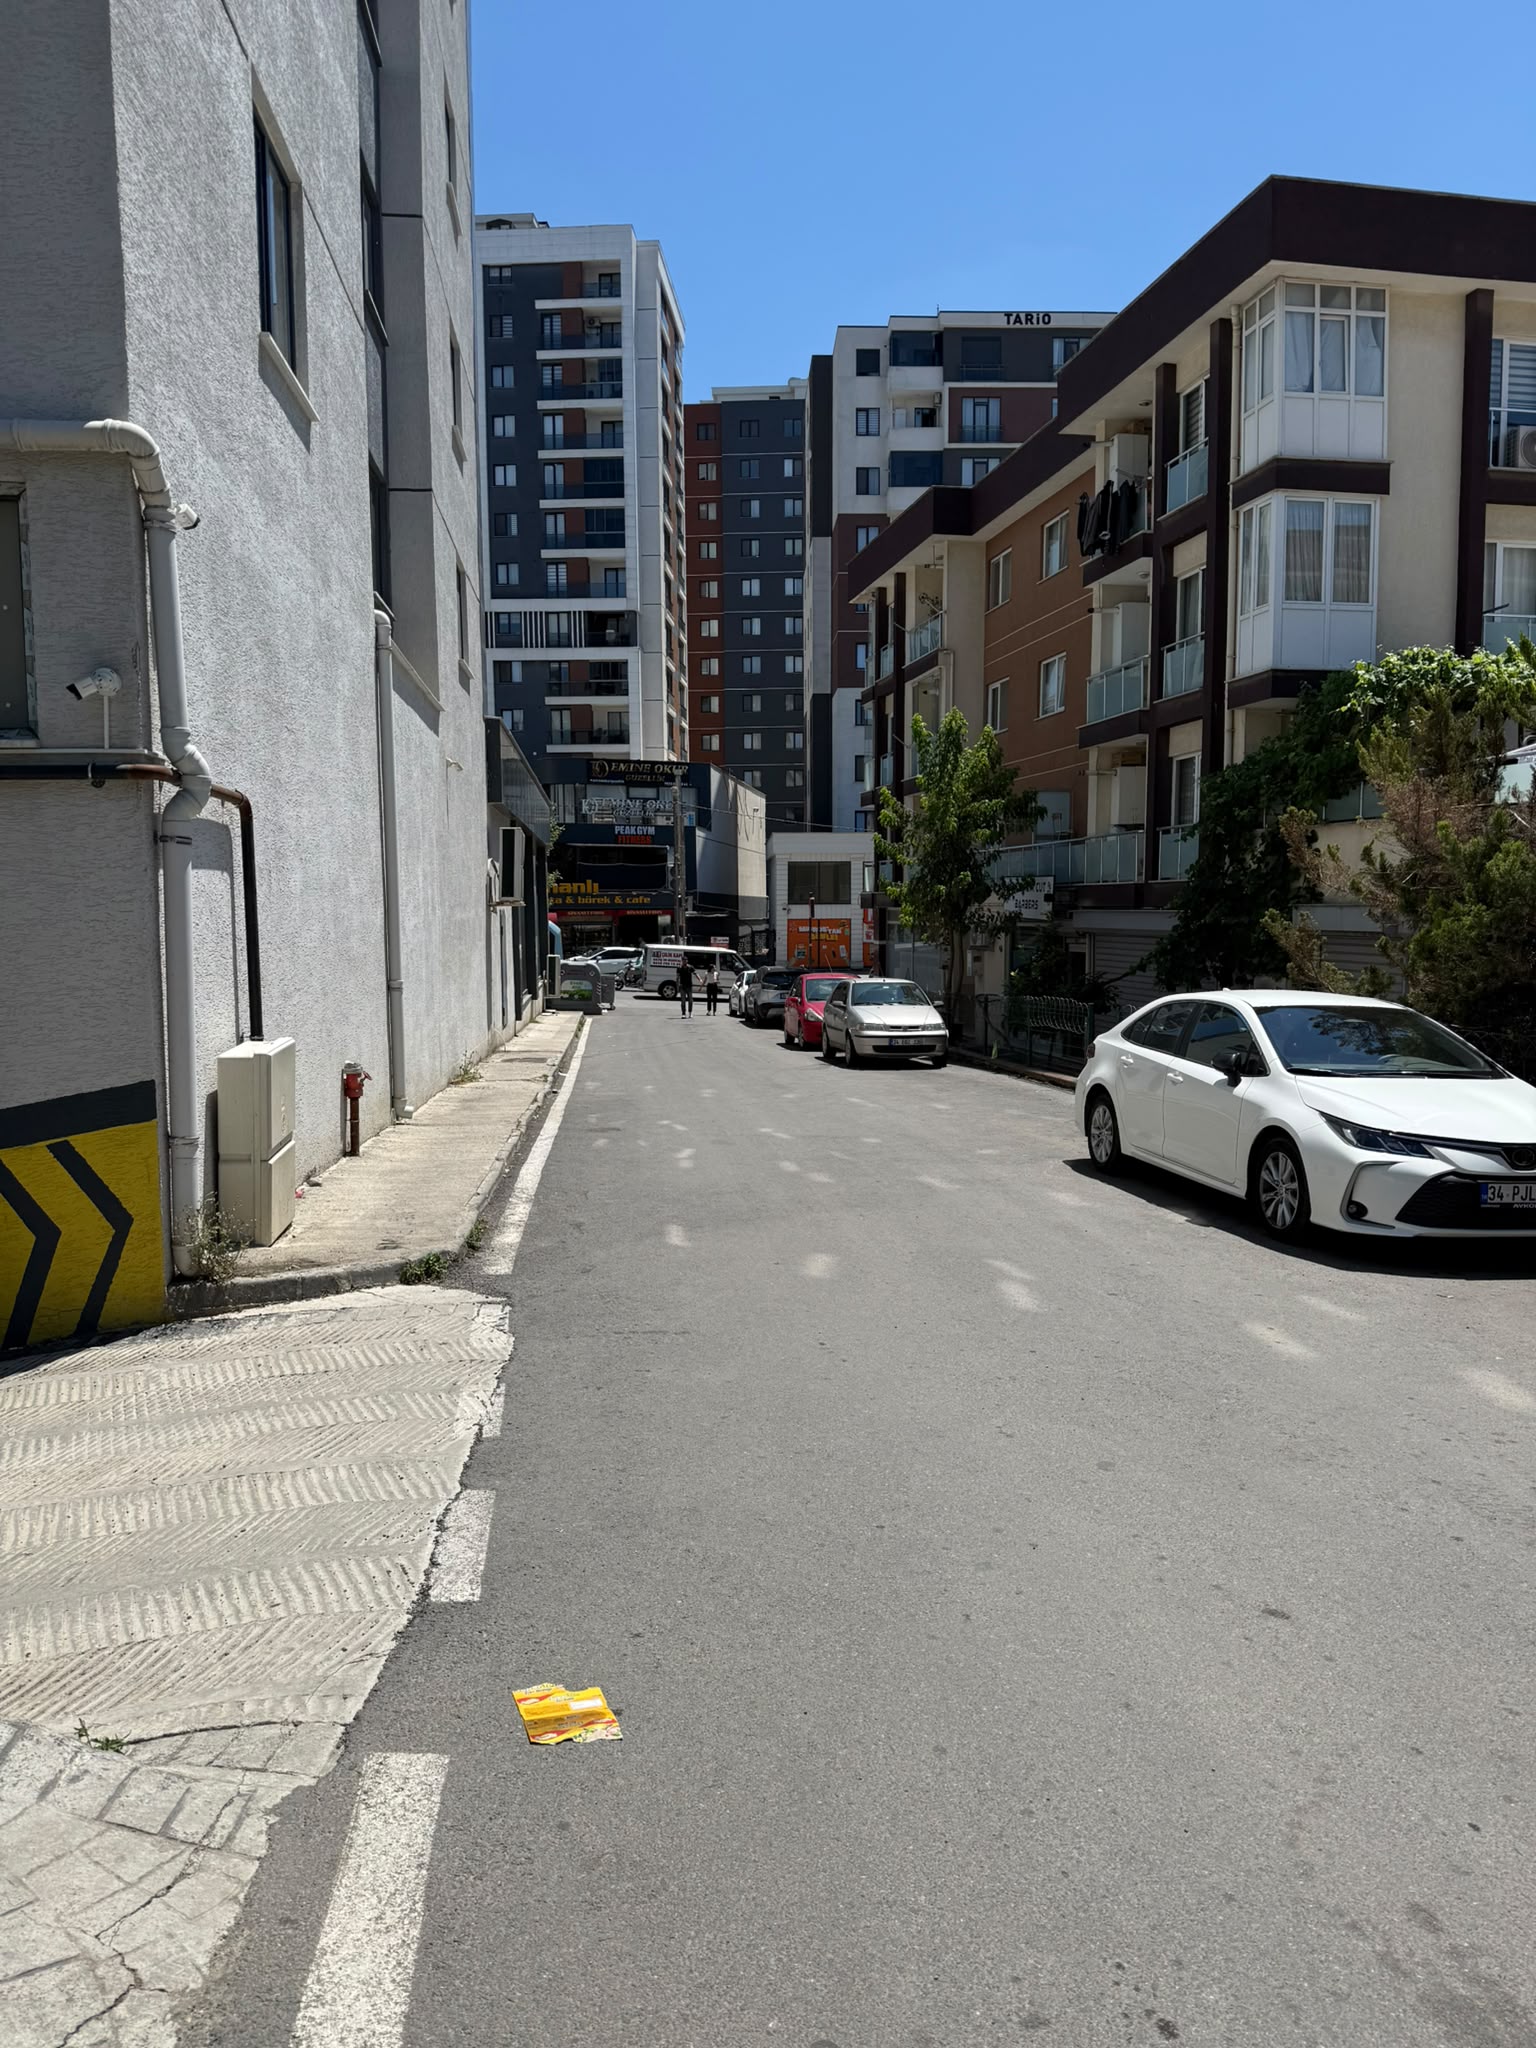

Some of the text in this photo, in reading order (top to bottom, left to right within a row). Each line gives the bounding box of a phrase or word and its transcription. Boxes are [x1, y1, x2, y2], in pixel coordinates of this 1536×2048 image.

[626, 895, 652, 904] cafe
[1489, 1185, 1536, 1201] 34 PJL
